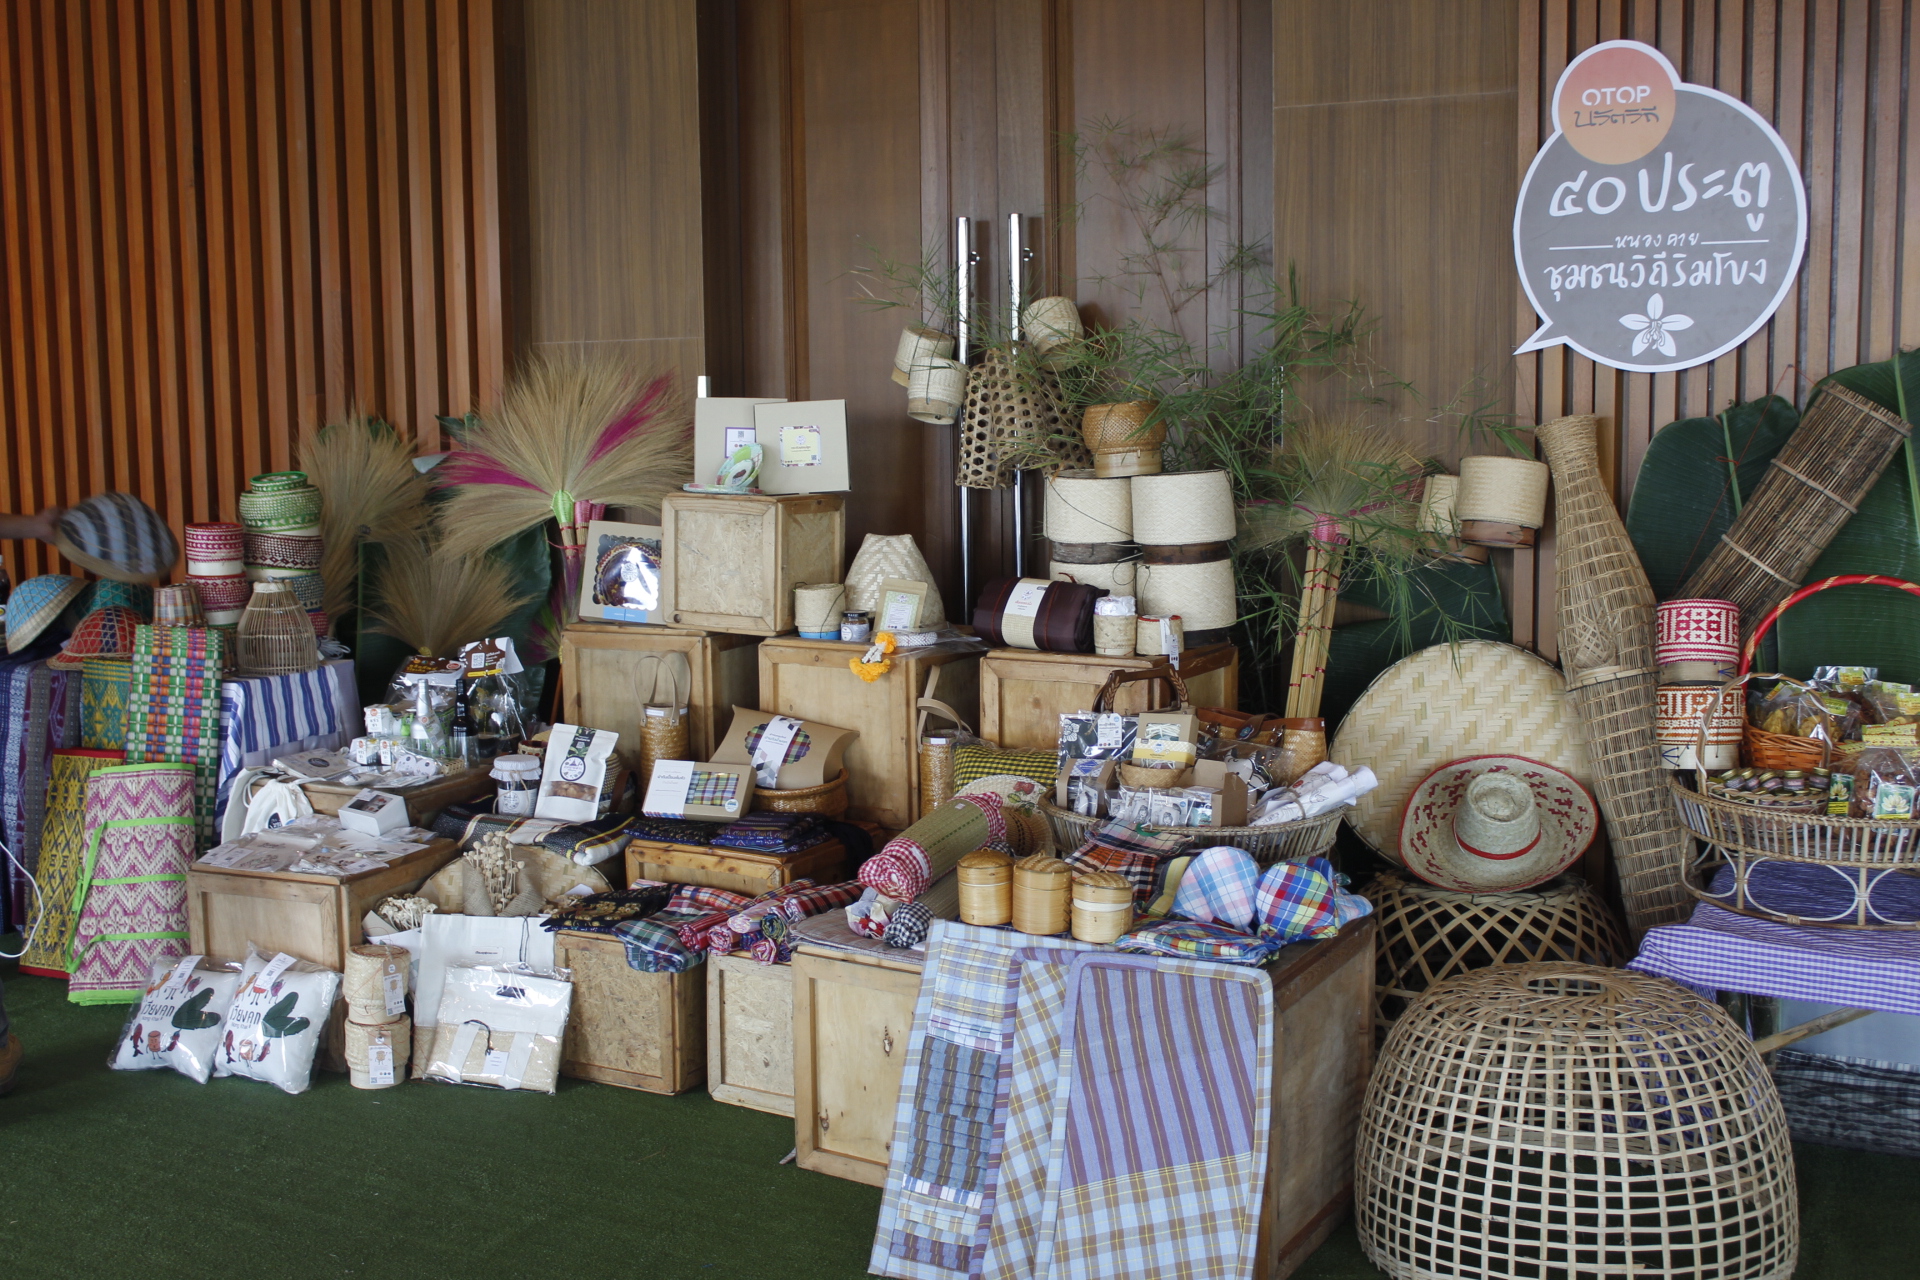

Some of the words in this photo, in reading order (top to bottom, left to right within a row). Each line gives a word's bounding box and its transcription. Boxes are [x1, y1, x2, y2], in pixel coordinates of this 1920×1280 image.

[1581, 85, 1651, 106] OTOP
[1574, 105, 1659, 128] นวัตวิถี
[1638, 151, 1771, 232] ประตู
[1543, 251, 1767, 302] ชุมชนวิถีริมโขง
